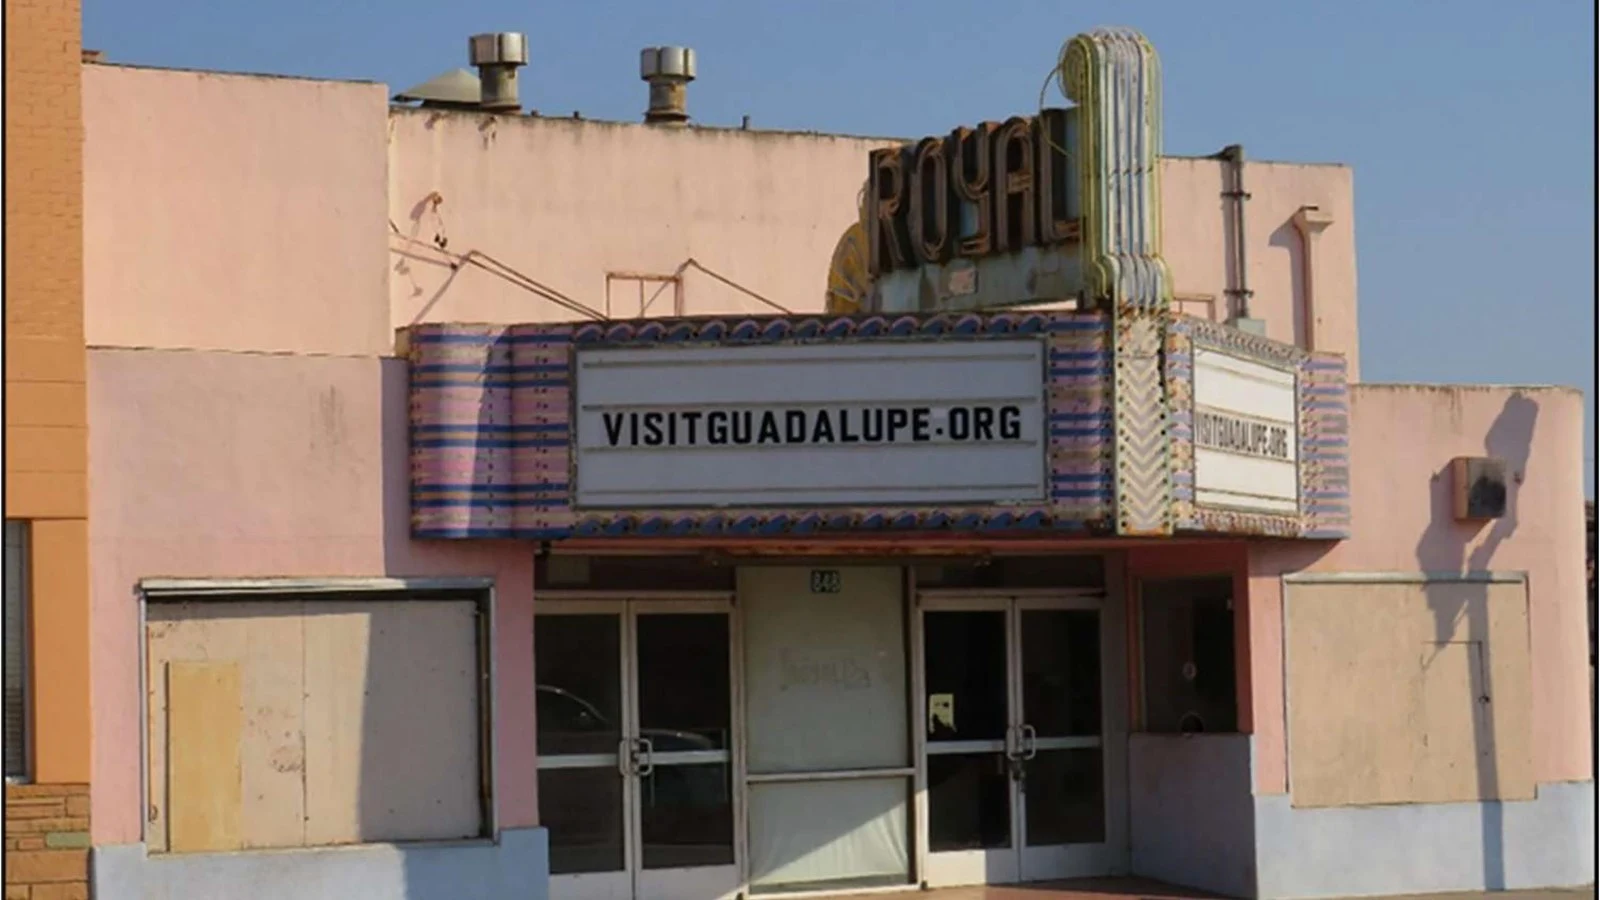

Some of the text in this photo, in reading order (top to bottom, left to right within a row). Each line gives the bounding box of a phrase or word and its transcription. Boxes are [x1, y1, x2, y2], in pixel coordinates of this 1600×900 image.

[868, 108, 1082, 279] ROYAL
[602, 405, 1022, 447] VISITGUADALUPE.ORG
[812, 571, 840, 593] 848
